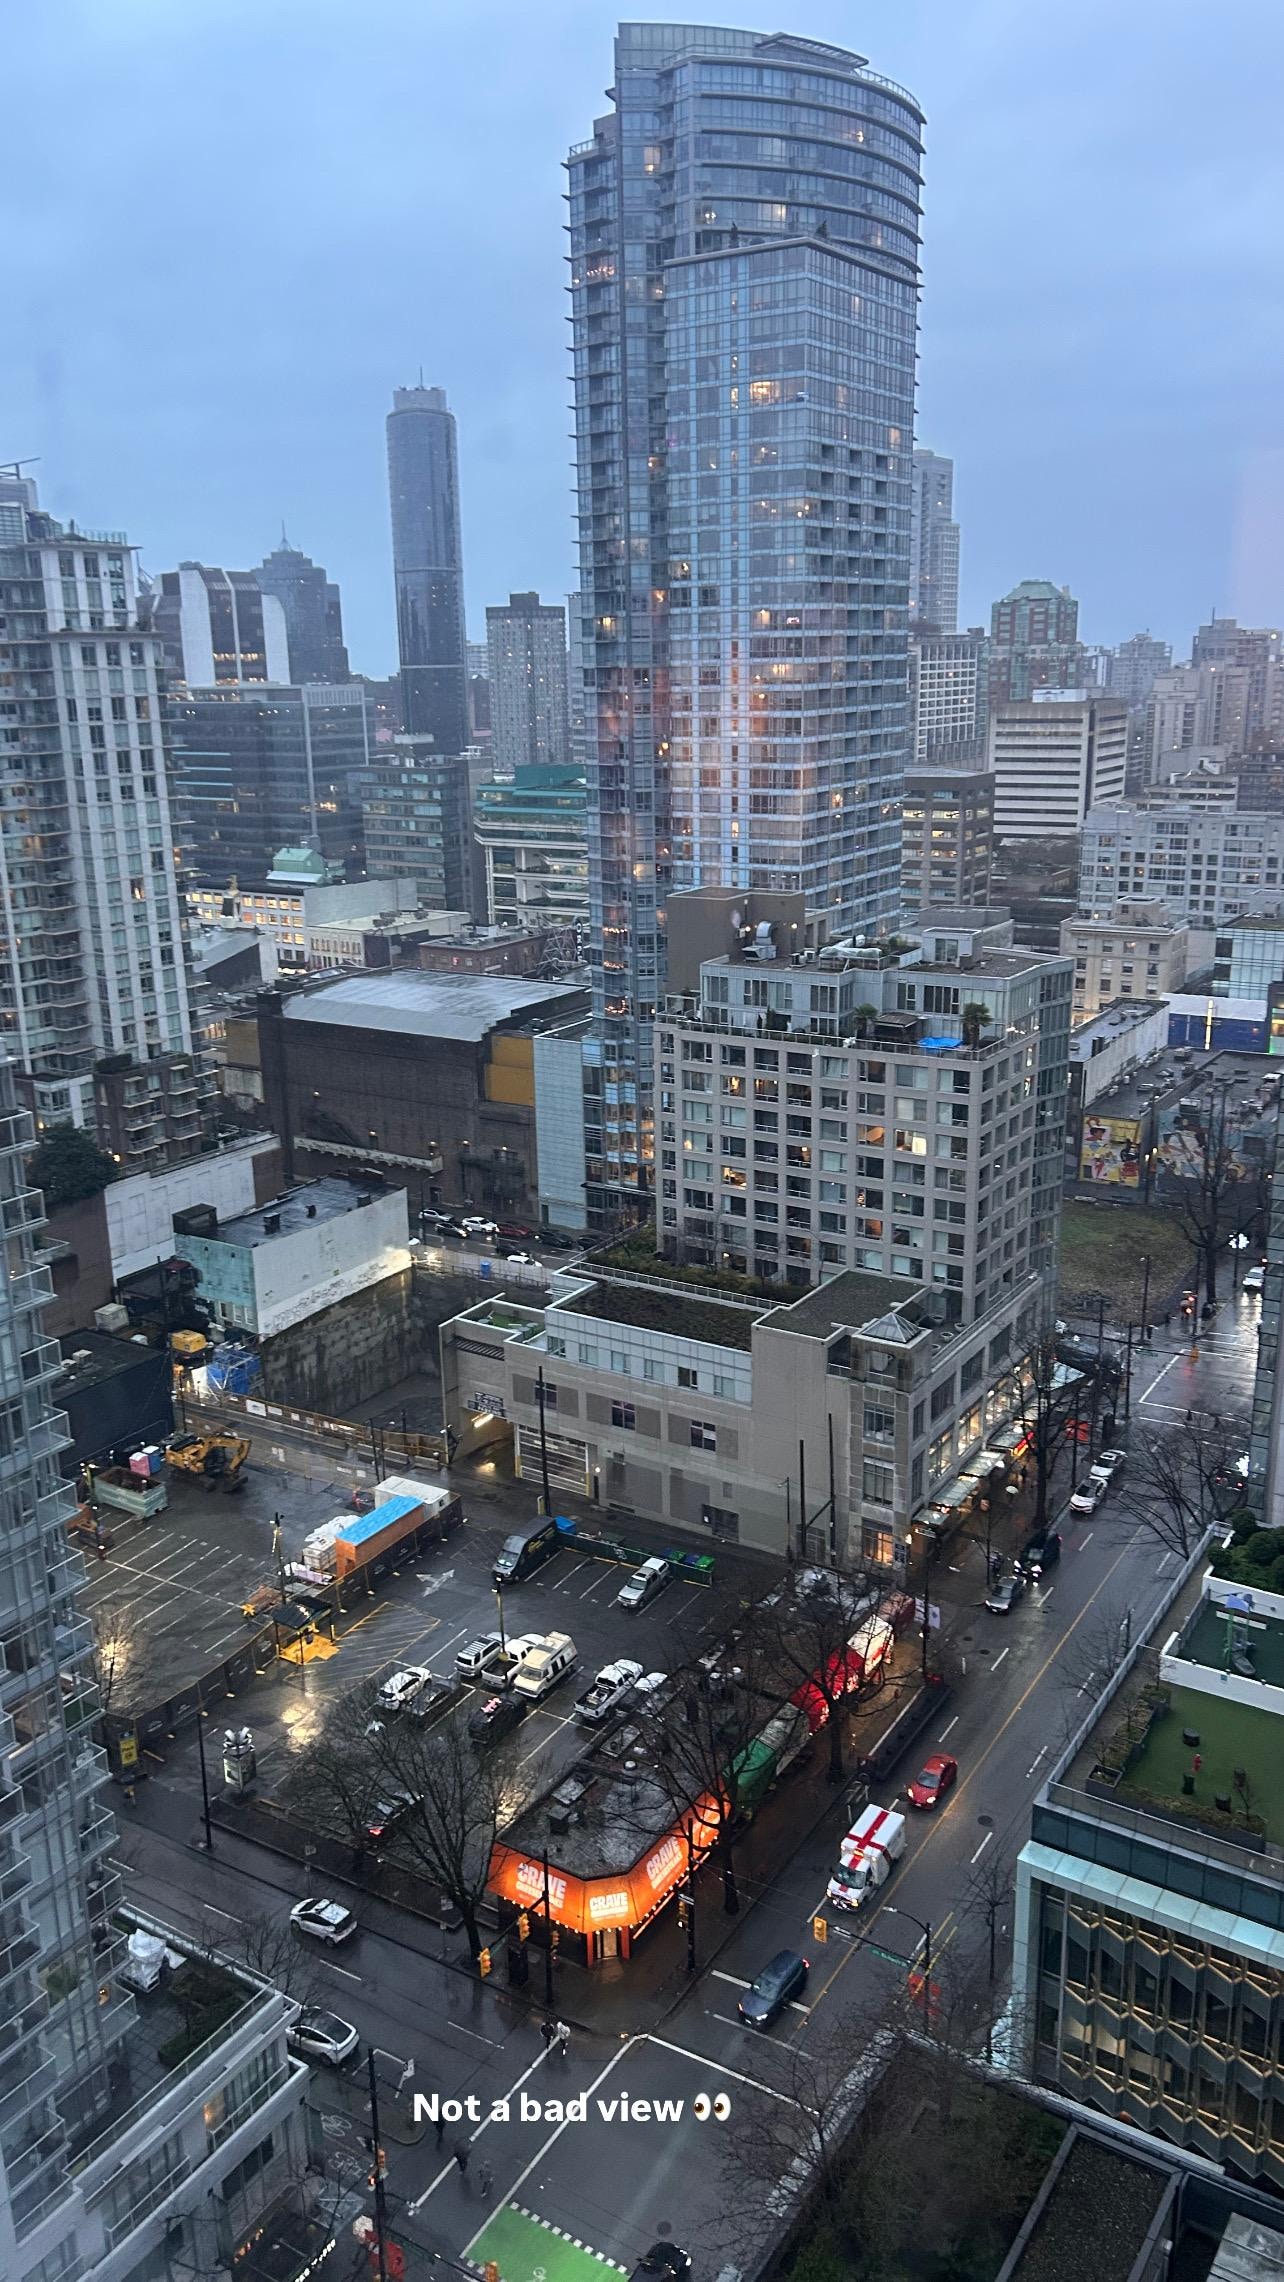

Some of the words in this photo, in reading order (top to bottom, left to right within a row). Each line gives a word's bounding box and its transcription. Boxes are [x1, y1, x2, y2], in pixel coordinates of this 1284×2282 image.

[645, 1835, 681, 1880] CRAVE
[517, 1862, 567, 1900] CRAVE
[589, 1891, 628, 1911] CRAVE
